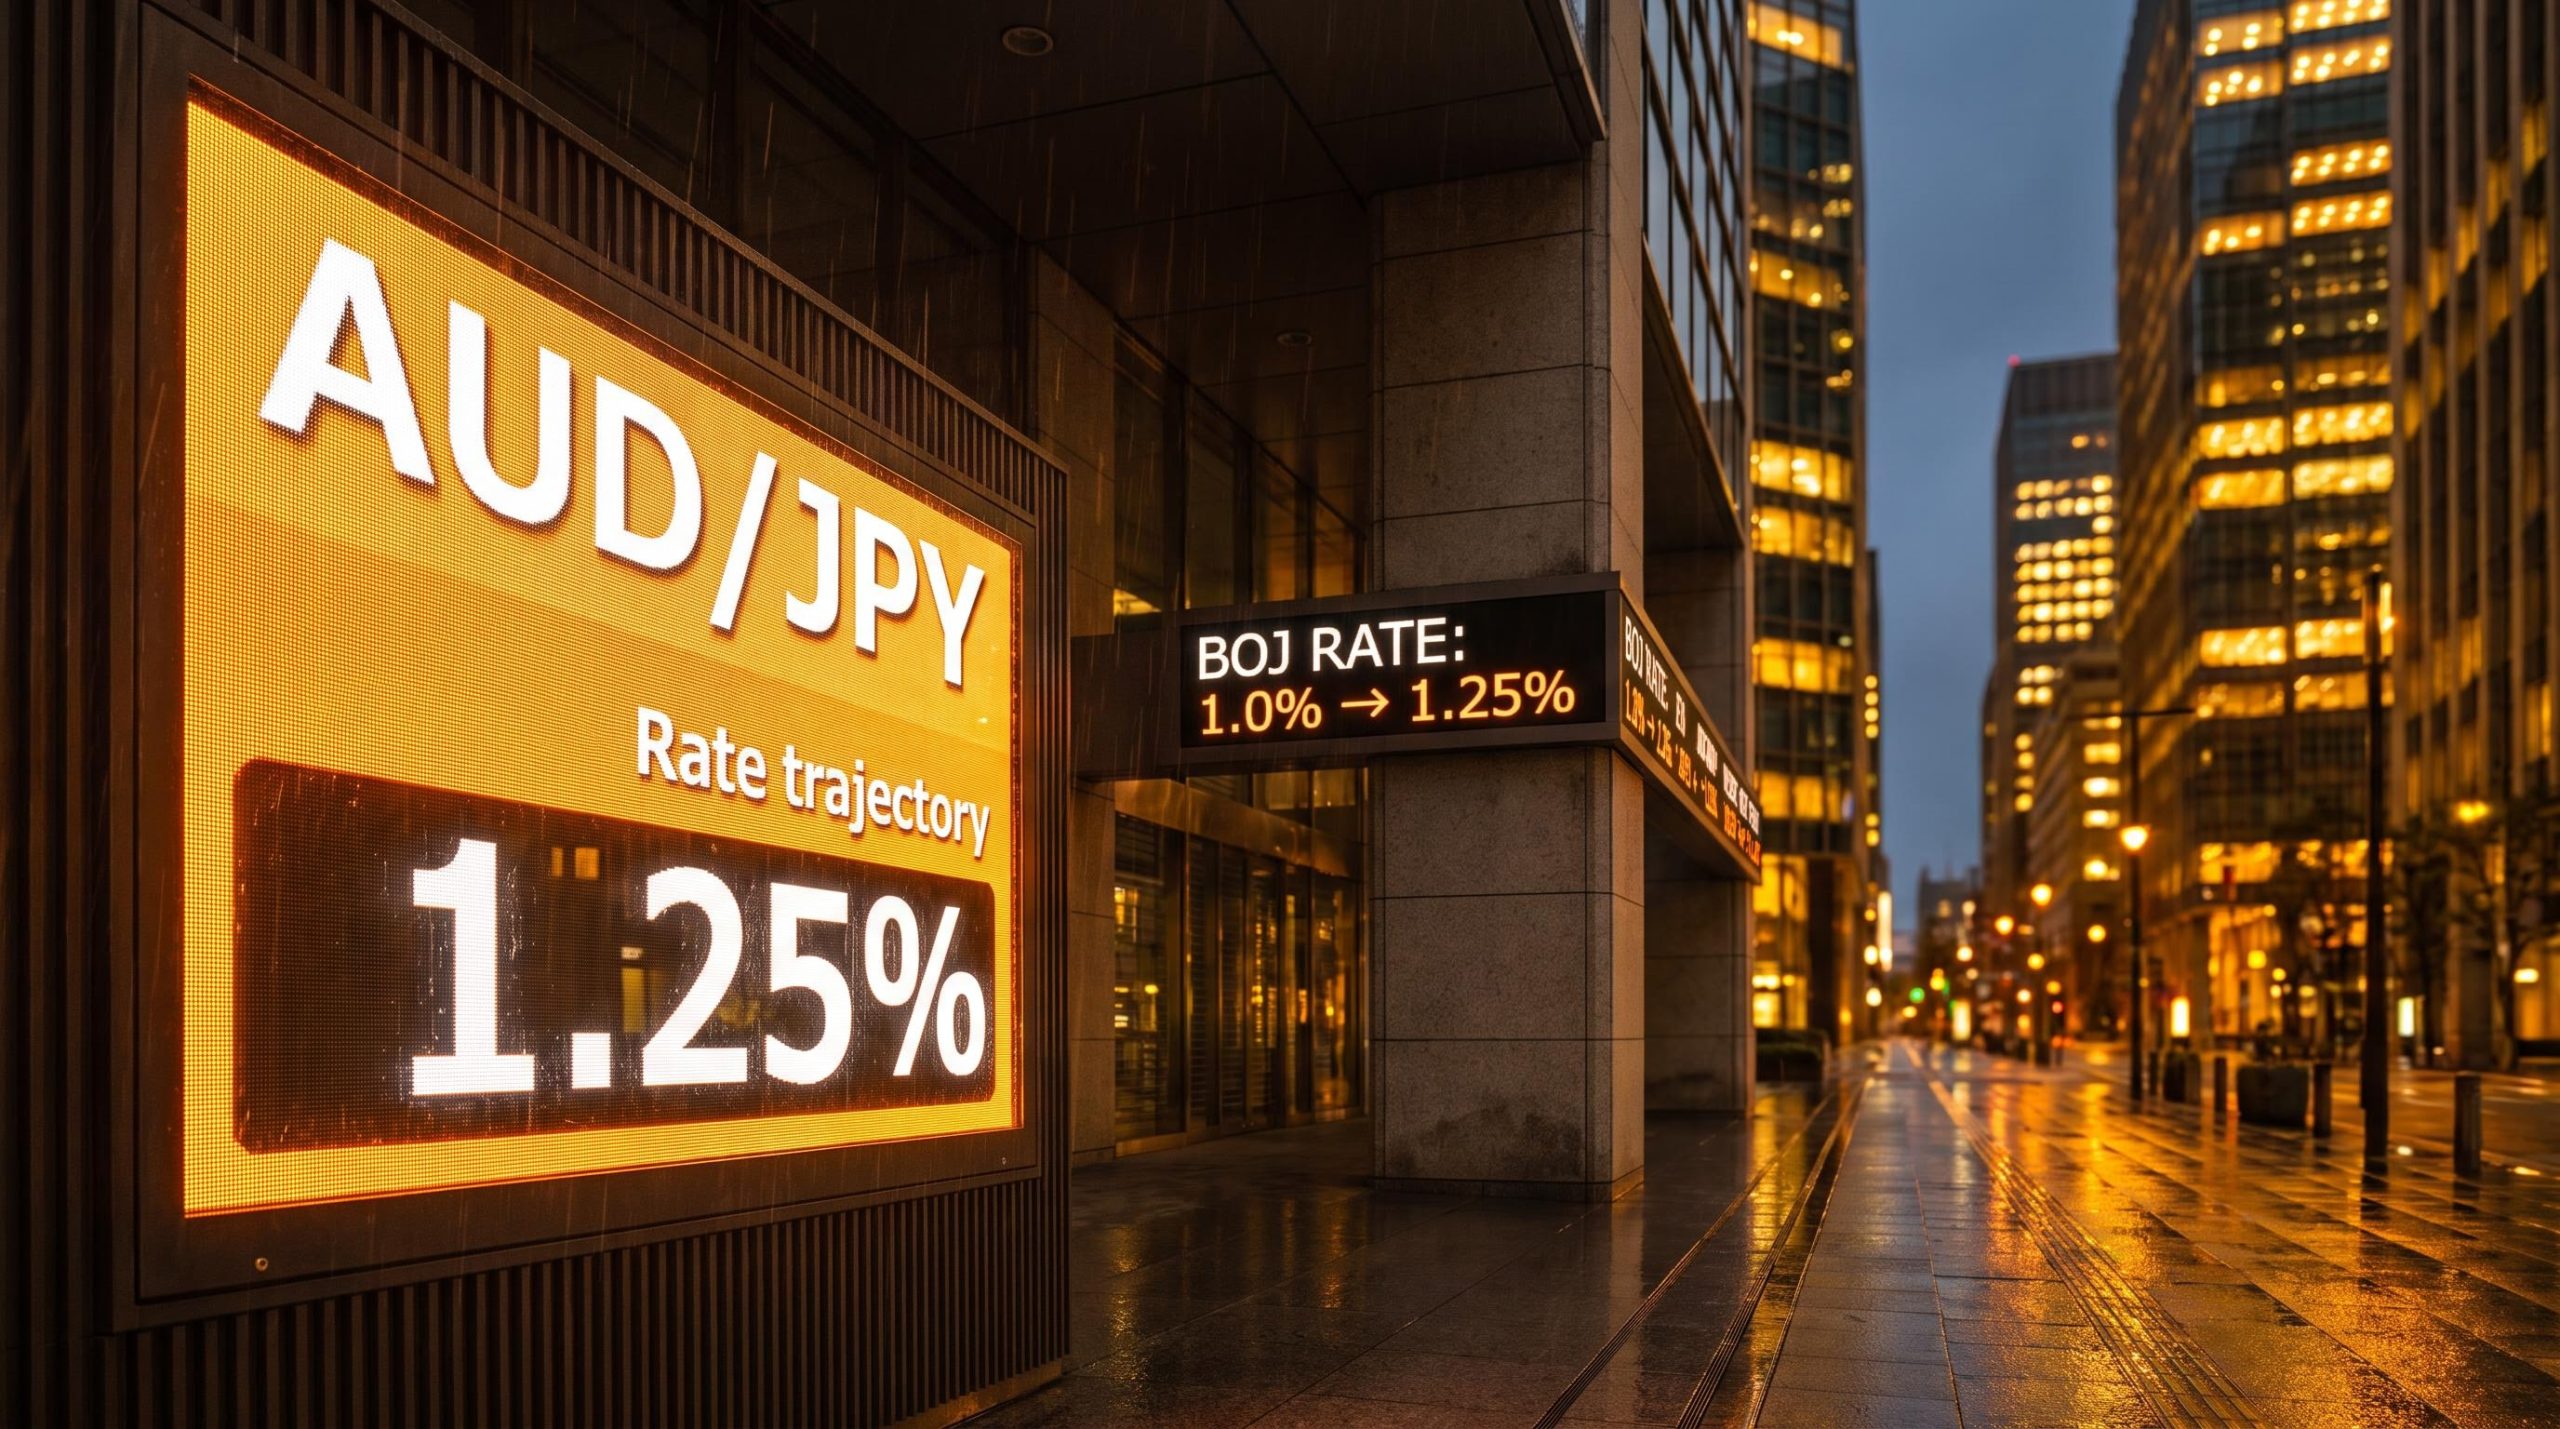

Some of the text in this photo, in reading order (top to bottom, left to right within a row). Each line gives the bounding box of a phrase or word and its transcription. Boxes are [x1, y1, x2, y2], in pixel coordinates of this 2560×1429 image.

[259, 237, 985, 687] AUD/JPY
[1198, 617, 1465, 680] BOJ RATE:
[1625, 615, 1643, 678] BOJ
[1202, 670, 1576, 736] 1.0% 1.25%
[637, 706, 991, 858] Rate trajectory
[411, 837, 986, 1097] 1.25%
